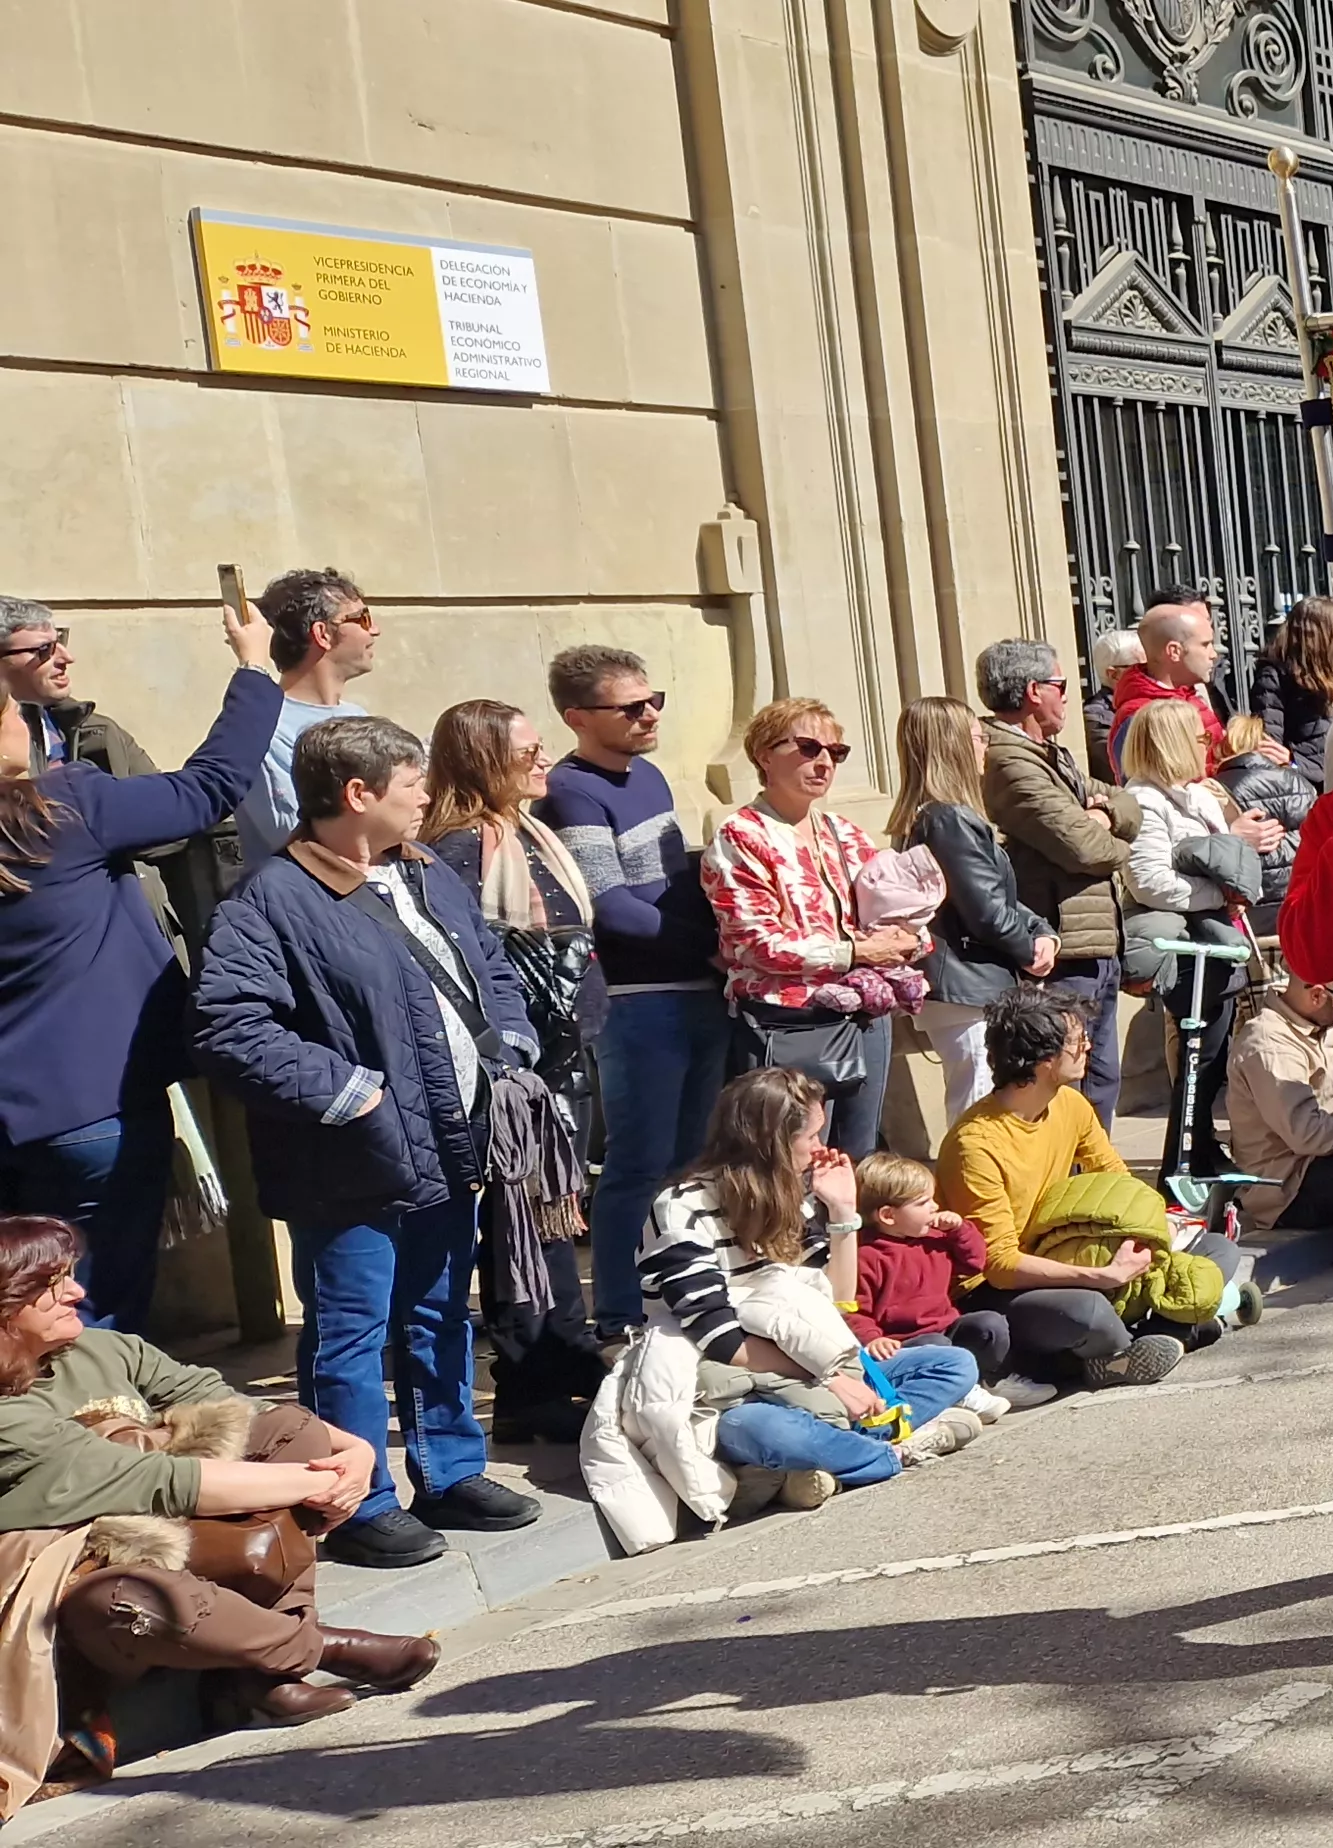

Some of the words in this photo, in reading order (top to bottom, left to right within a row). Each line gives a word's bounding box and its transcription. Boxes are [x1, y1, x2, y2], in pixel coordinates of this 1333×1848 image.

[313, 256, 415, 277] VICEPRESIDENCIA
[440, 259, 511, 277] DELEGACIÓN
[316, 272, 366, 288] PRIMERA
[368, 278, 391, 291] DEL
[442, 275, 458, 287] DE
[460, 277, 520, 293] ECONOMÍA
[520, 283, 528, 294] Y
[318, 289, 383, 306] GOBIERNO
[444, 291, 502, 306] HACIENDA
[323, 326, 390, 342] MINISTERIO
[448, 320, 503, 335] TRIBUNAL
[325, 341, 342, 354] DE
[345, 343, 408, 359] HACIENDA
[450, 336, 521, 352] ECONÓMICO
[453, 352, 542, 369] ADMINISTRATIVO
[455, 367, 512, 381] REGIONAL
[1185, 1053, 1199, 1126] GLOBBER
